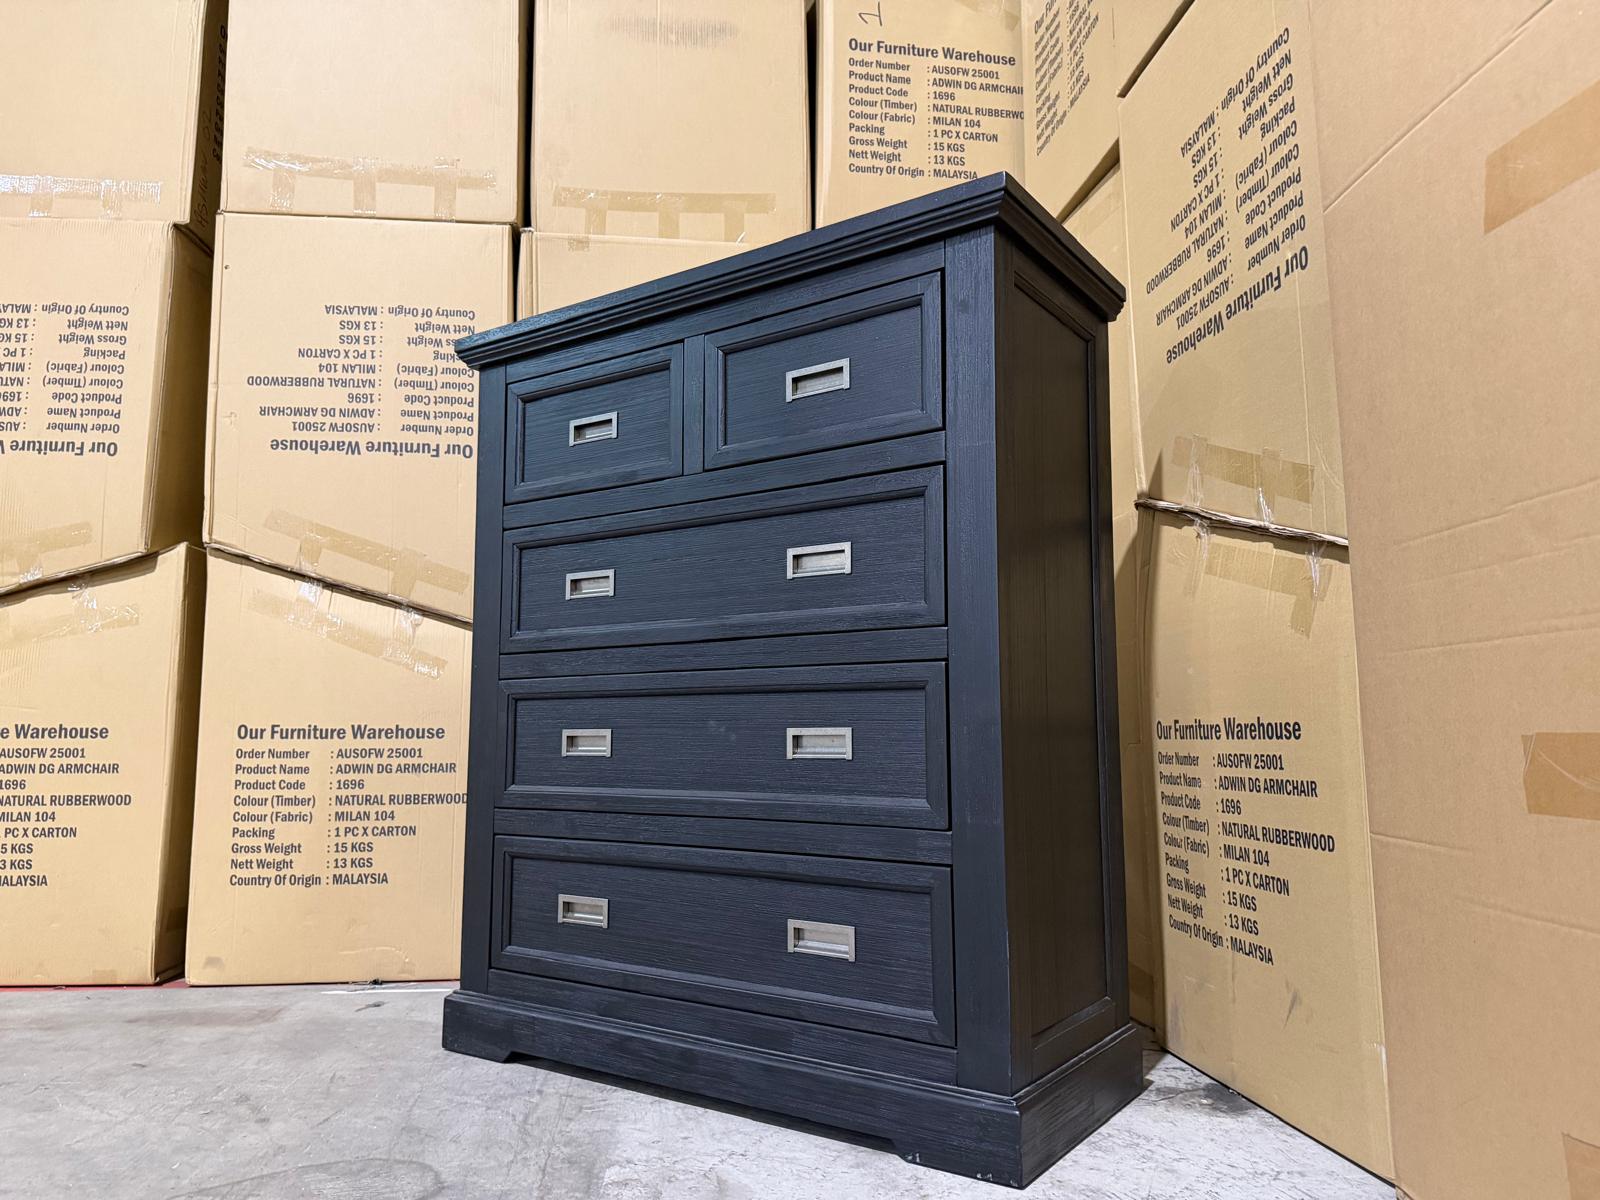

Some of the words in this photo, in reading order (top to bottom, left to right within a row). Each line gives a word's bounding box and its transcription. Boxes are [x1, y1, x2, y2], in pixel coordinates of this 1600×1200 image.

[849, 38, 873, 52] Our
[877, 40, 938, 58] Furniture
[942, 46, 1015, 66] Warehouse
[1256, 27, 1289, 72] Country
[848, 57, 874, 68] Order
[875, 59, 910, 71] Number
[931, 65, 970, 77] AUSOFW
[971, 68, 999, 79] 25001
[849, 70, 883, 82] Product
[885, 73, 911, 84] Name
[931, 77, 962, 89] ADWIN
[964, 81, 977, 90] DG
[1245, 66, 1254, 88] Of
[849, 83, 884, 95] Product
[885, 86, 908, 97] Code
[933, 90, 955, 101] 1696
[1221, 78, 1244, 110] Origin
[848, 96, 878, 107] Colour
[880, 99, 917, 112] (Timber)
[932, 103, 973, 115] NATURAL
[849, 122, 885, 136] Packing
[933, 129, 938, 138] 1
[941, 130, 953, 139] PC
[954, 131, 960, 139] X
[962, 131, 998, 142] CARTON
[1180, 110, 1215, 158] MALAYSIA
[1270, 143, 1299, 179] Colour
[848, 163, 884, 176] Country
[885, 165, 896, 175] Of
[898, 166, 924, 178] Origin
[933, 168, 978, 179] MALAYSIA
[1235, 169, 1269, 213] (Timber)
[1267, 166, 1301, 208] Product
[1245, 199, 1266, 224] Code
[1191, 213, 1224, 253] NATURAL
[1206, 234, 1225, 262] 1696
[1146, 244, 1191, 294] RUBBERWOOD
[1284, 245, 1308, 278] Our
[1225, 265, 1281, 320] Furniture
[41, 302, 72, 314] Origin
[74, 305, 86, 315] Of
[88, 303, 129, 316] Country
[324, 305, 377, 315] MALAYSIA
[388, 304, 418, 317] Origin
[420, 308, 432, 318] Of
[435, 306, 475, 321] Country
[1166, 311, 1224, 363] Warehouse
[42, 375, 86, 388] (Timber)
[88, 378, 123, 389] Colour
[247, 376, 324, 387] RUBBERWOOD
[327, 377, 375, 388] NATURAL
[394, 378, 438, 391] (Timber)
[440, 381, 474, 392] Colour
[347, 392, 374, 404] 1696
[404, 394, 430, 406] Code
[433, 395, 474, 407] Product
[259, 406, 318, 417] ARMCHAIR
[320, 407, 335, 417] DG
[339, 408, 375, 418] ADWIN
[400, 409, 430, 420] Name
[433, 410, 473, 422] Product
[292, 421, 326, 432] 25001
[328, 422, 375, 432] AUSOFW
[400, 424, 442, 435] Number
[444, 425, 473, 436] Order
[9, 440, 84, 456] Furniture
[88, 441, 117, 456] Our
[270, 439, 361, 455] Warehouse
[365, 441, 439, 457] Furniture
[444, 444, 473, 458] Our
[14, 723, 108, 739] Warehouse
[237, 724, 266, 739] Our
[270, 724, 346, 739] Furniture
[351, 724, 445, 739] Warehouse
[1156, 720, 1172, 739] Our
[1174, 718, 1221, 740] Furniture
[1223, 716, 1301, 740] Warehouse
[0, 747, 47, 758] AUSOFW
[49, 747, 85, 758] 25001
[235, 748, 265, 759] Order
[268, 748, 310, 759] Number
[336, 748, 384, 759] AUSOFW
[386, 747, 423, 758] 25001
[235, 763, 277, 774] Product
[279, 764, 309, 774] Name
[335, 763, 373, 774] ADWIN
[377, 763, 392, 773] DG
[395, 762, 456, 773] ARMCHAIR
[1158, 751, 1174, 765] Order
[1174, 752, 1199, 766] Number
[1216, 753, 1251, 769] AUSOFW
[1253, 753, 1284, 770] 25001
[0, 763, 35, 774] ADWIN
[38, 763, 54, 774] DG
[57, 763, 119, 774] ARMCHAIR
[234, 779, 276, 790] Product
[278, 779, 305, 790] Code
[336, 779, 364, 789] 1696
[1159, 771, 1182, 786] Product
[1182, 772, 1201, 788] Name
[1218, 775, 1246, 792] ADWIN
[1248, 777, 1261, 793] DG
[1263, 778, 1318, 797] ARMCHAIR
[233, 795, 268, 806] Colour
[271, 795, 315, 807] (Timber)
[335, 794, 386, 806] NATURAL
[388, 793, 468, 805] RUBBERWOOD
[233, 811, 268, 822] Colour
[270, 811, 312, 822] (Fabric)
[334, 810, 370, 821] MILAN
[374, 810, 395, 821] 104
[232, 827, 275, 838] Packing
[334, 826, 341, 837] 1
[344, 826, 359, 837] PC
[361, 826, 368, 837] X
[371, 825, 416, 836] CARTON
[1162, 812, 1181, 828] Colour
[1182, 815, 1209, 836] (Timber)
[1221, 821, 1260, 841] NATURAL
[1261, 826, 1335, 852] RUBBERWOOD
[231, 842, 261, 853] Gross
[264, 842, 301, 855] Weight
[334, 842, 347, 853] 15
[351, 841, 373, 852] KGS
[230, 858, 253, 869] Nett
[256, 858, 293, 871] Weight
[333, 857, 347, 868] 13
[350, 857, 373, 868] KGS
[229, 874, 272, 888] Country
[274, 874, 287, 885] Of
[289, 874, 321, 887] Origin
[332, 873, 388, 885] MALAYSIA
[1165, 852, 1189, 874] Packing
[1225, 867, 1230, 882] 1
[1232, 868, 1243, 885] PC
[1244, 870, 1251, 887] X
[1252, 872, 1289, 896] CARTON
[1166, 872, 1183, 891] Gross
[1183, 877, 1206, 899] Weight
[1227, 890, 1237, 906] 15
[1239, 893, 1257, 912] KGS
[1169, 914, 1192, 938] Country
[1193, 923, 1200, 939] Of
[1201, 926, 1223, 948] Origin
[1230, 935, 1273, 965] MALAYSIA
